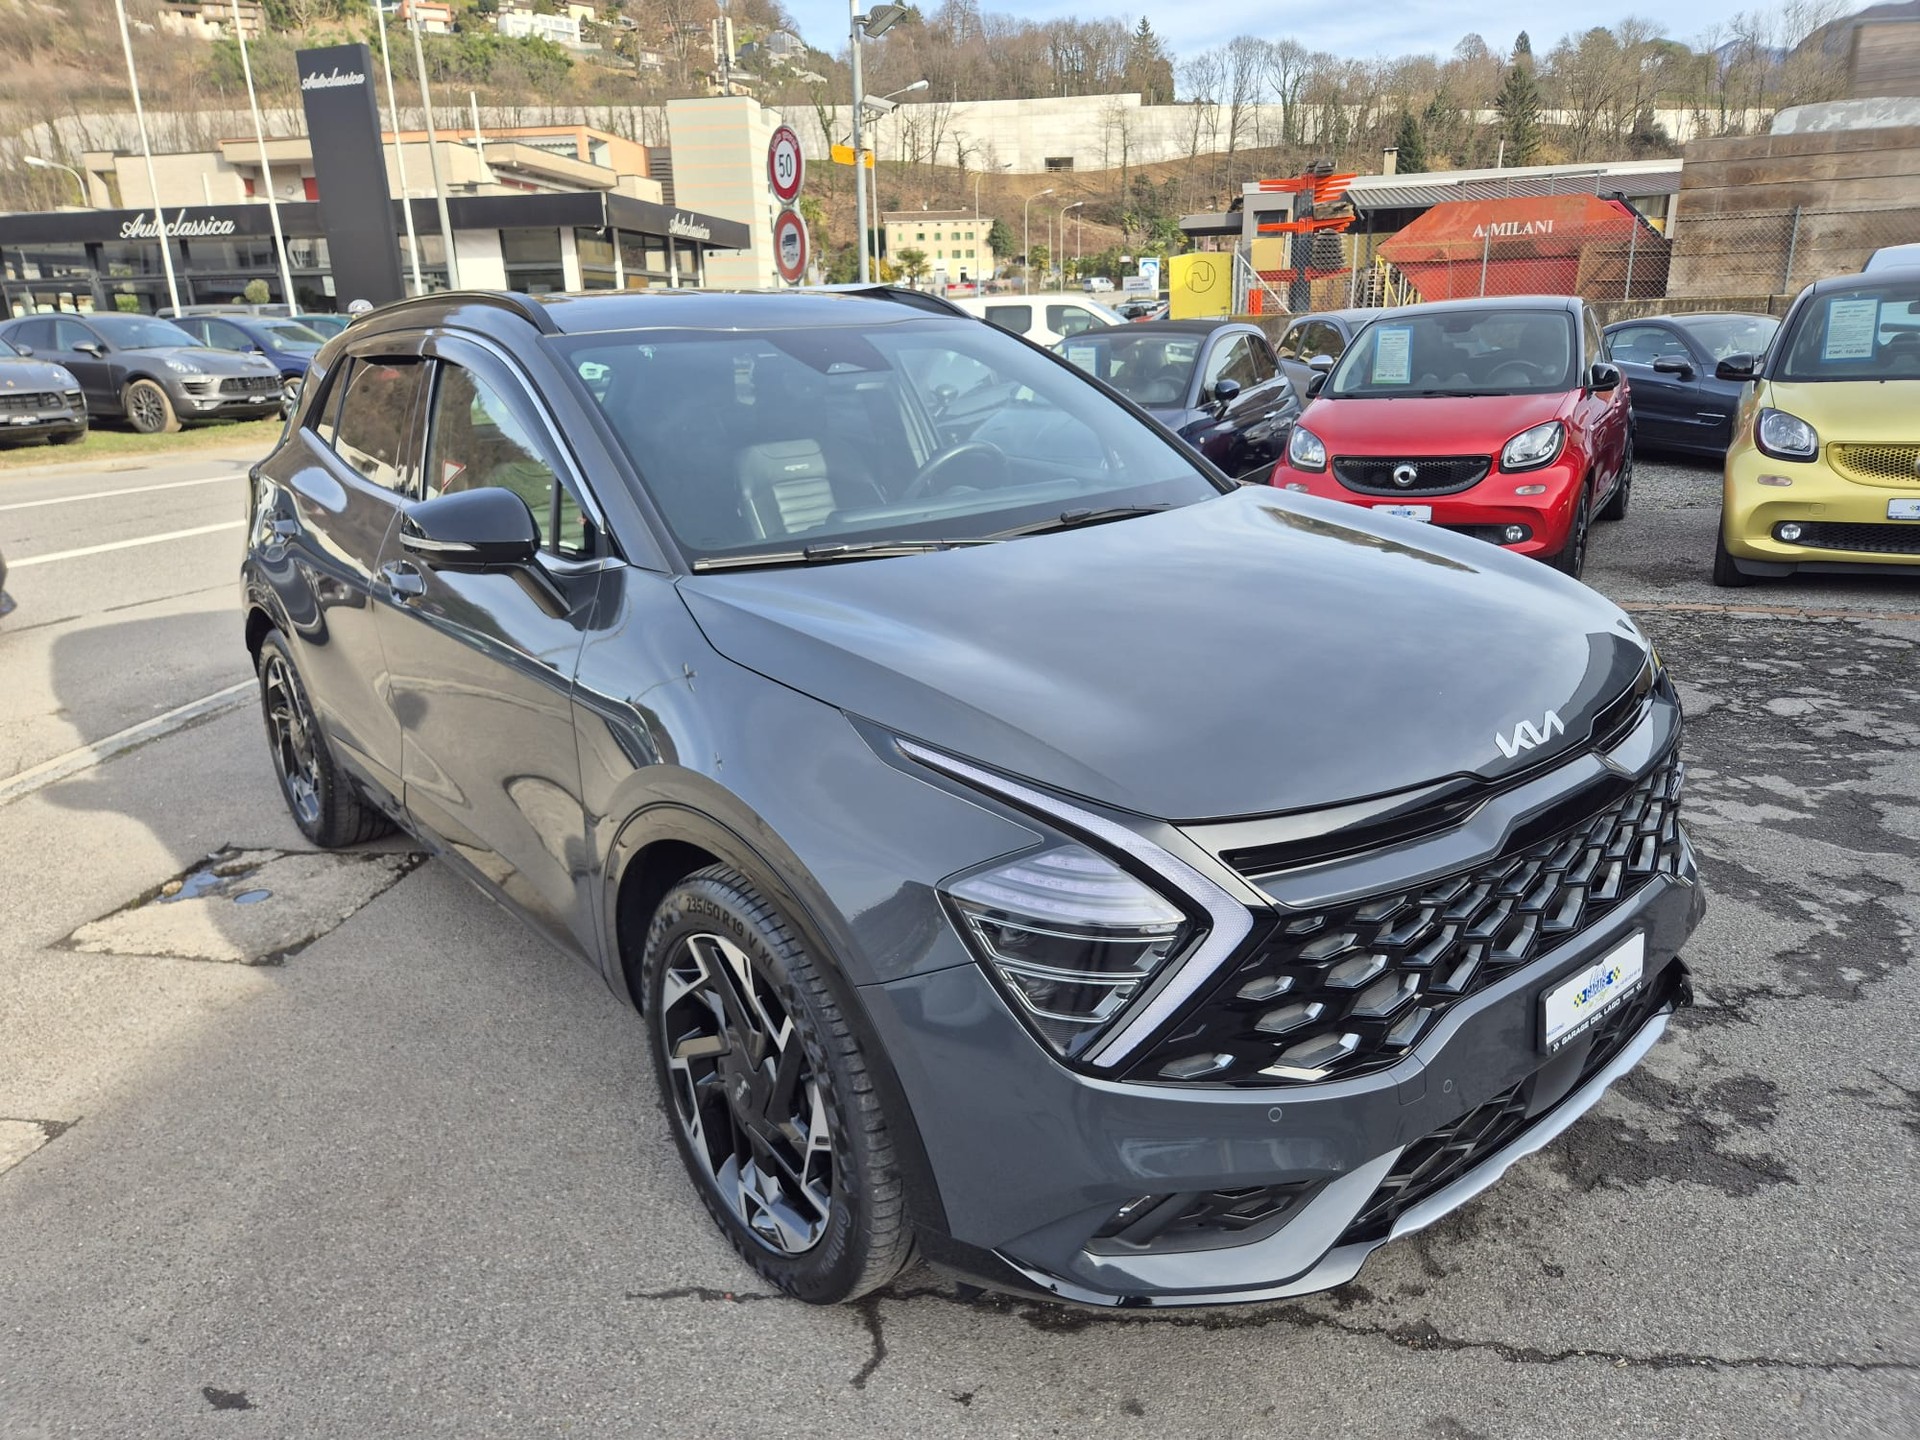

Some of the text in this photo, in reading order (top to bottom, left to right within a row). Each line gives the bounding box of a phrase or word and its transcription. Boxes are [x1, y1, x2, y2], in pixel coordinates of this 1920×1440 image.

[778, 153, 793, 178] 50
[1495, 709, 1564, 758] KIA
[686, 898, 720, 920] 235/50
[722, 911, 730, 928] R
[732, 918, 744, 937] 19
[1561, 1021, 1590, 1045] GARAGE
[1590, 1012, 1603, 1025] DEL
[1603, 999, 1621, 1015] LAGO
